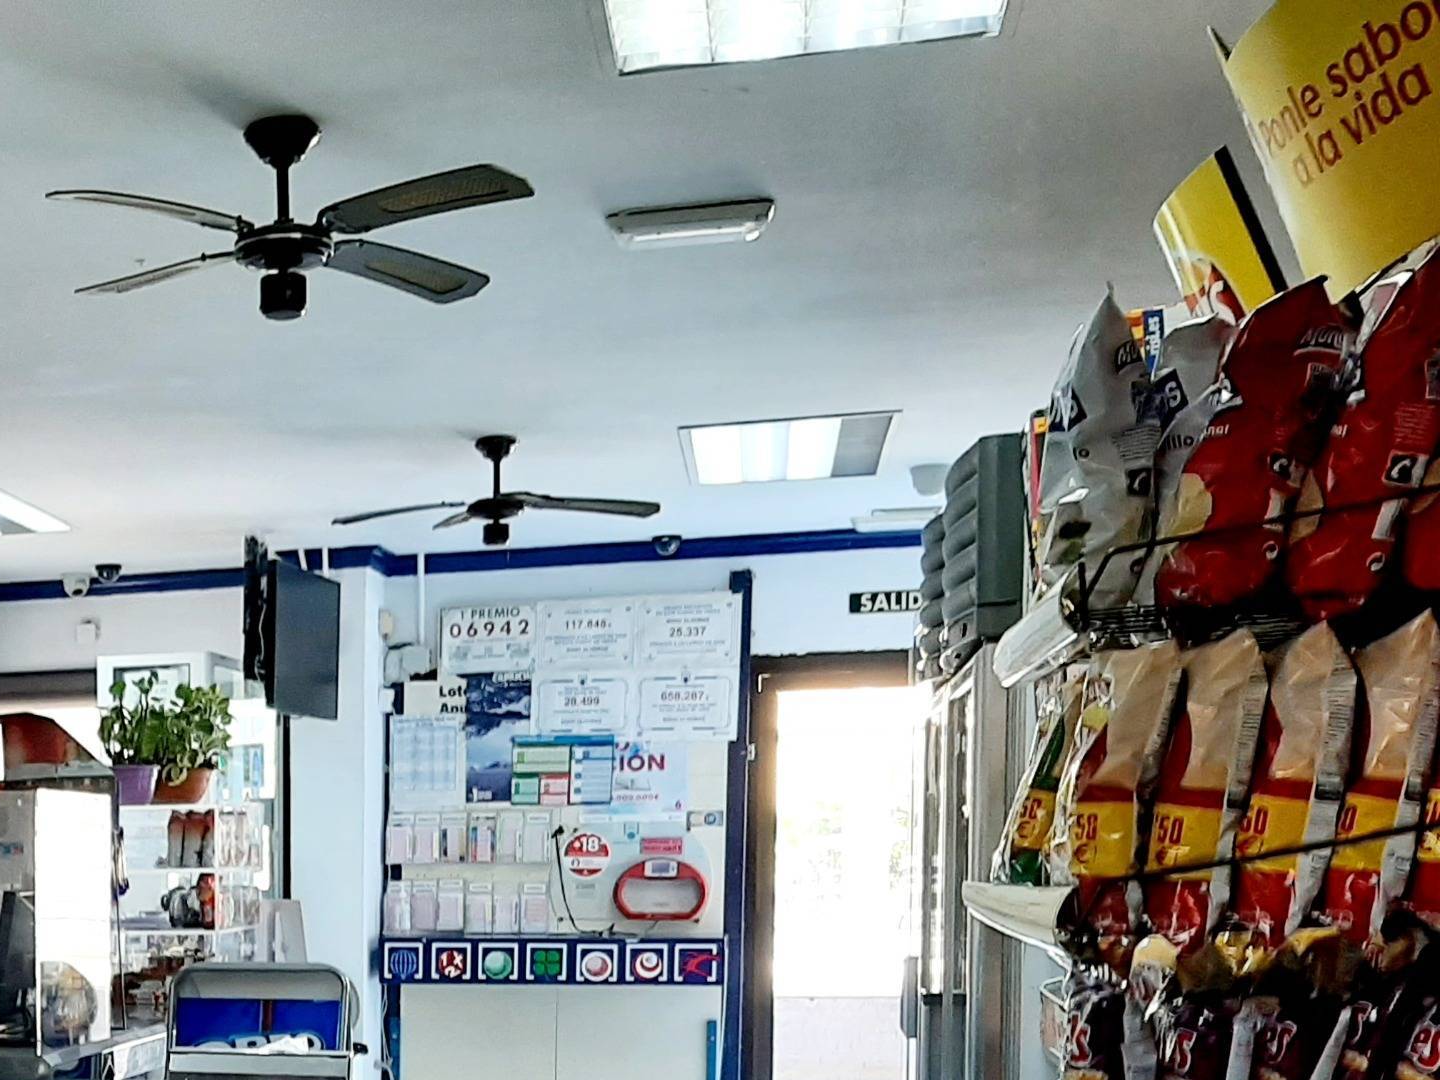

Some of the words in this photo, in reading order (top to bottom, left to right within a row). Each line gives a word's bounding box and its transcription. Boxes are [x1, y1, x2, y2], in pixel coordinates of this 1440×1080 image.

[1304, 129, 1343, 174] la
[1339, 63, 1433, 145] vida
[471, 607, 521, 619] PREMIO
[449, 618, 530, 639] 06942
